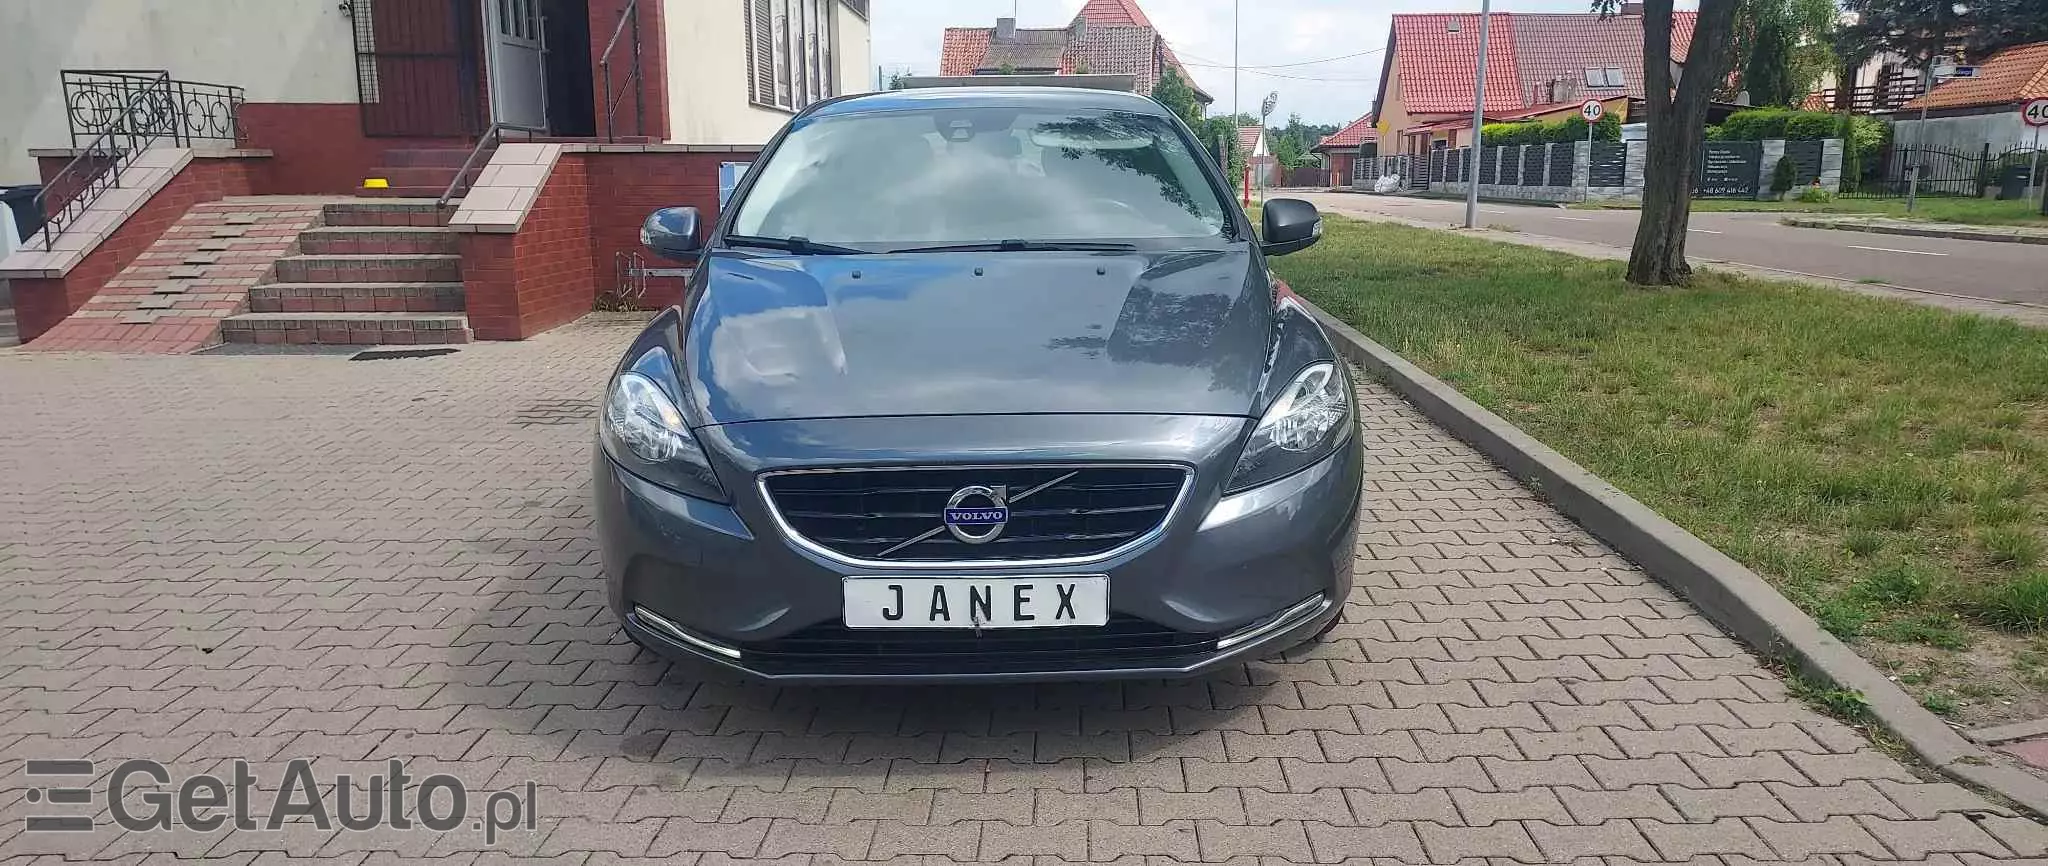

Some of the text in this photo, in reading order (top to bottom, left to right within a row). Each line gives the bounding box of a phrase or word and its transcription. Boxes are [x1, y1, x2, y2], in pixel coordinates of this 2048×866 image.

[1584, 105, 1600, 116] 40
[949, 511, 1003, 521] VOLVO
[882, 584, 1076, 621] JANEX
